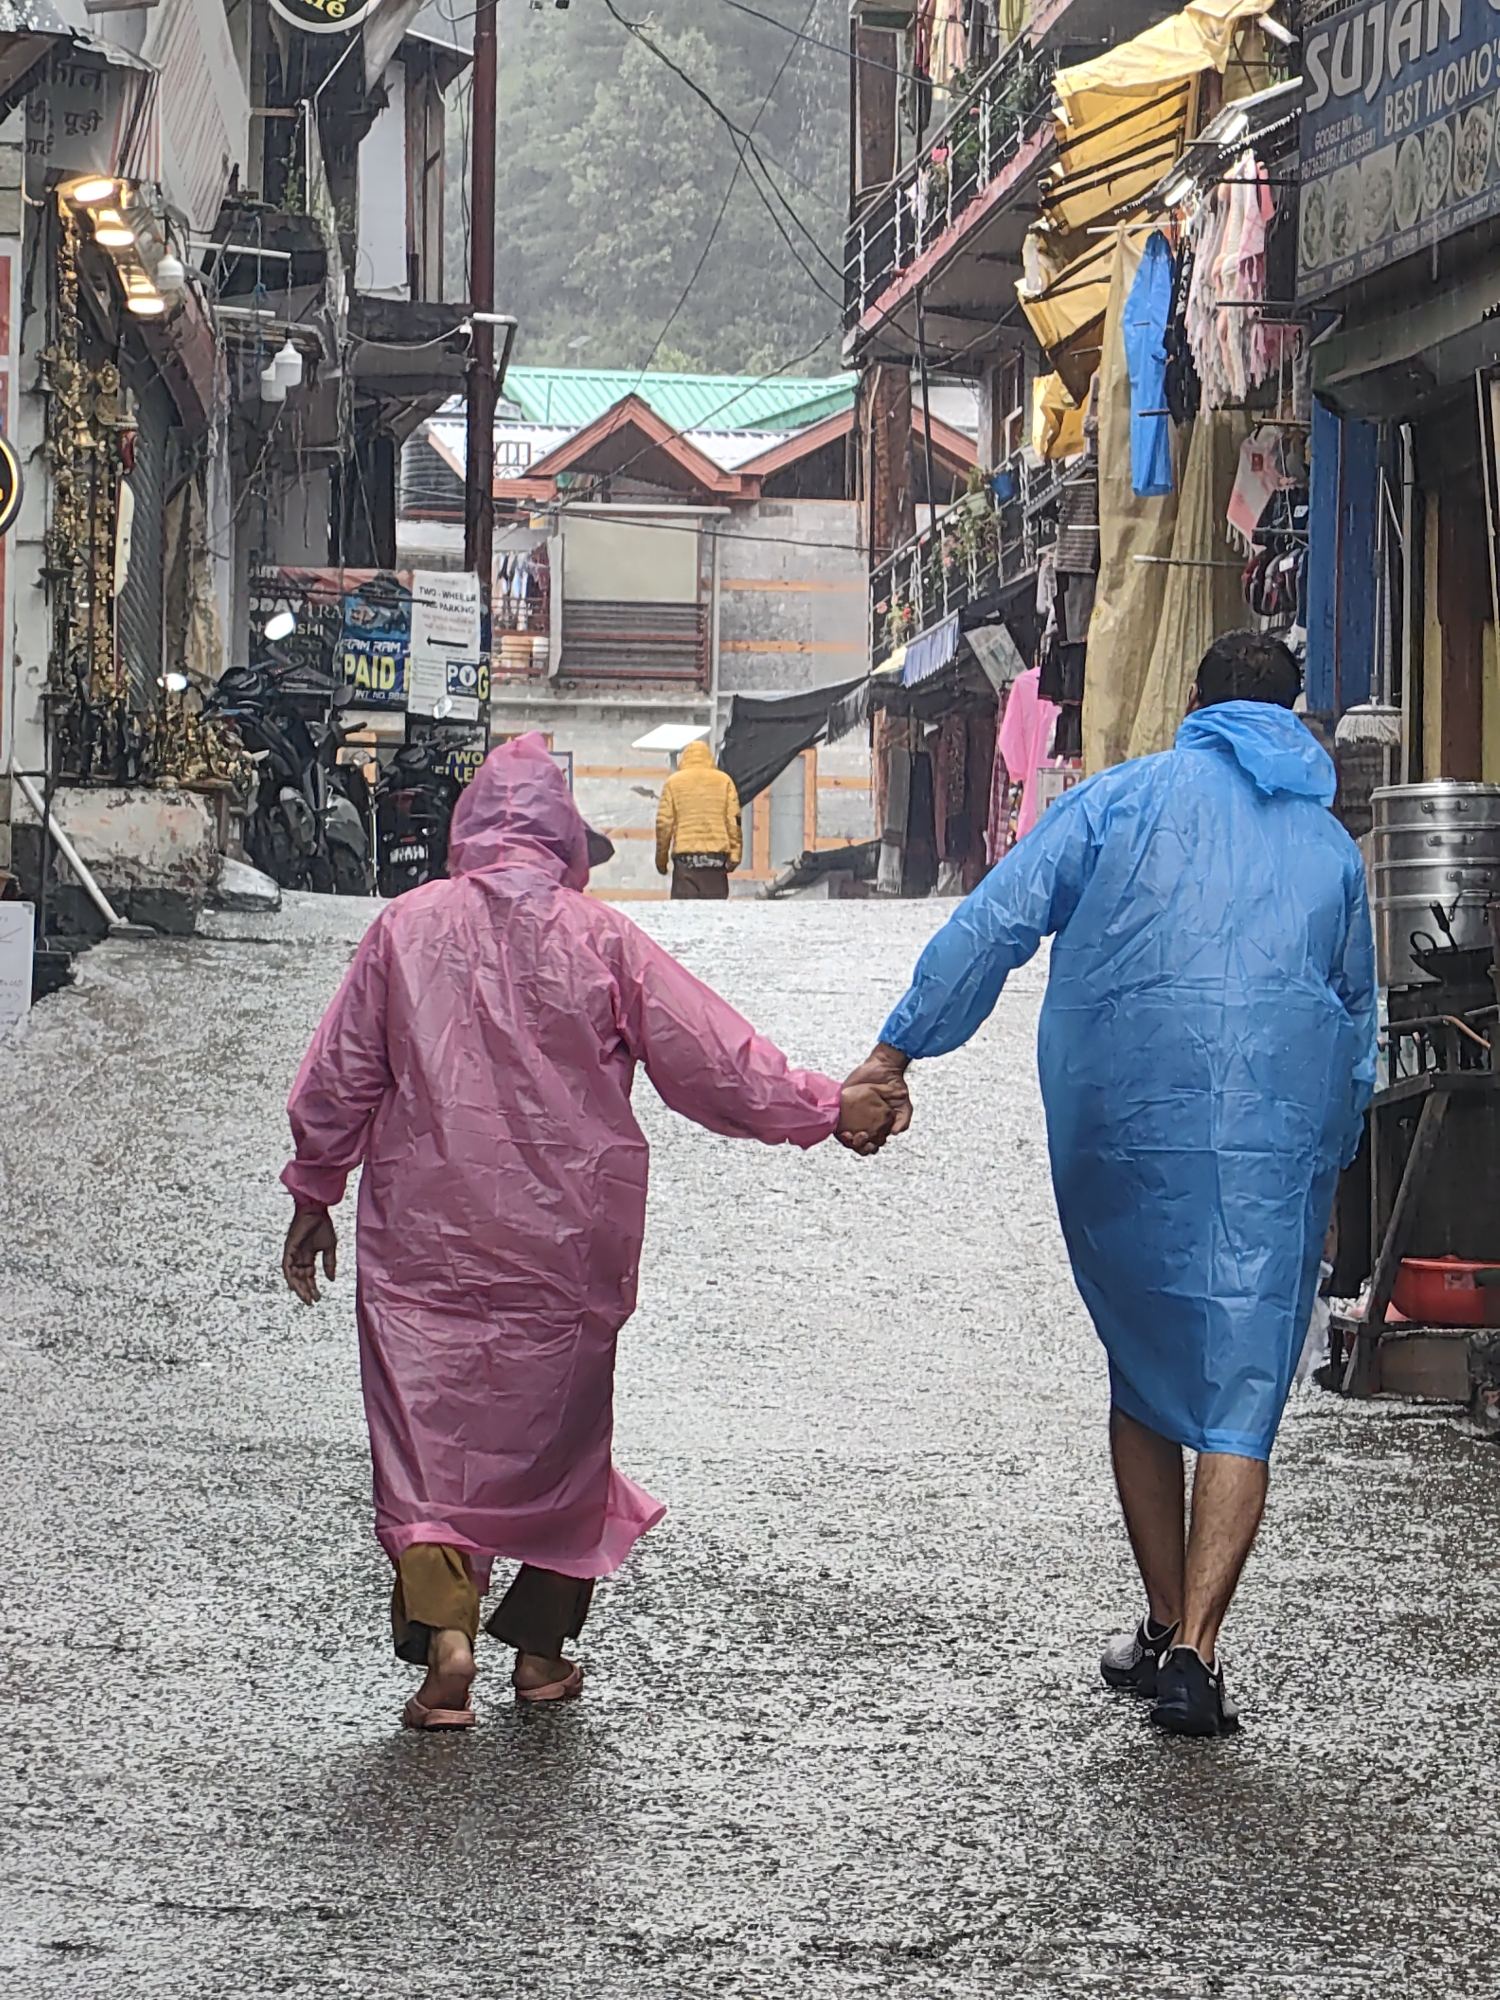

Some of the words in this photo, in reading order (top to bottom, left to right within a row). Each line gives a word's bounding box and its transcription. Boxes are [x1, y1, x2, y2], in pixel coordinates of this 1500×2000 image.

[1305, 0, 1461, 112] SUJAN
[1384, 81, 1422, 136] BEST
[1315, 121, 1341, 152] GOOGLE
[419, 585, 437, 597] TWO
[440, 602, 475, 615] PARKING
[373, 641, 401, 653] RAM
[344, 653, 395, 691] PAID
[446, 750, 485, 767] TWO
